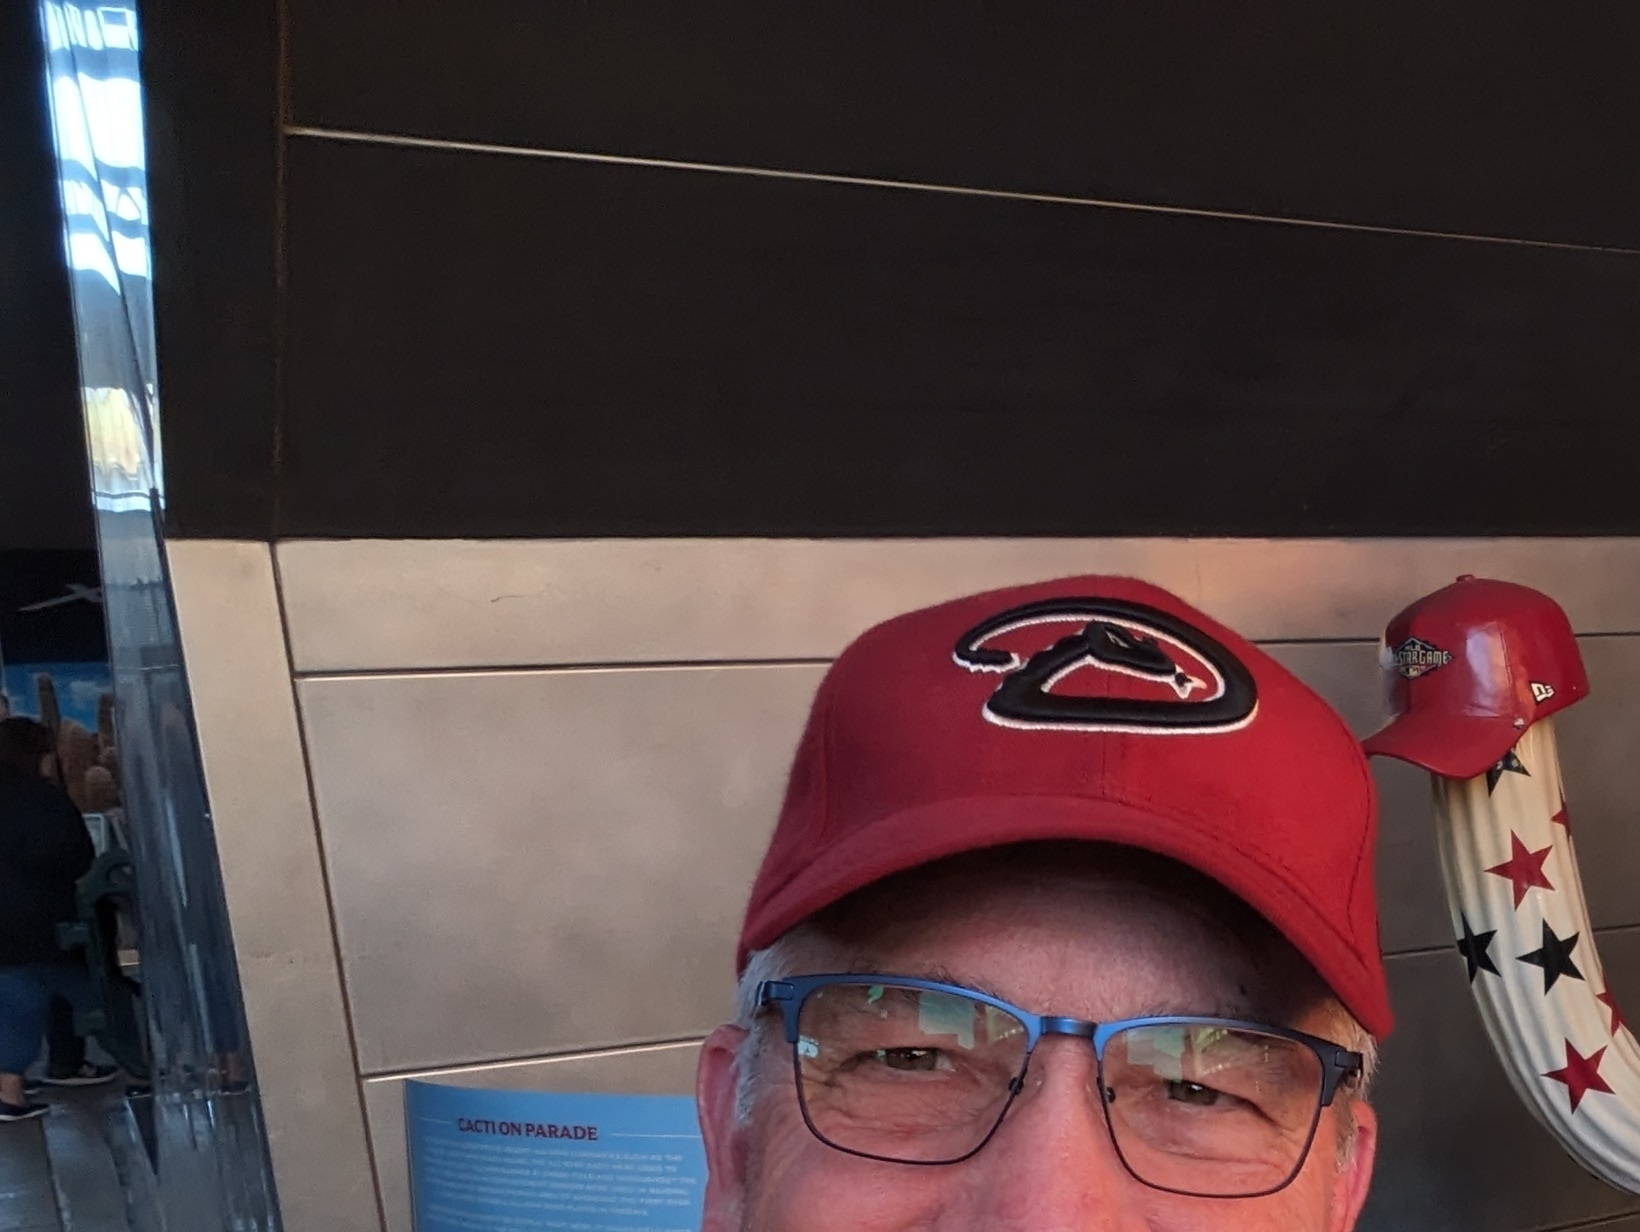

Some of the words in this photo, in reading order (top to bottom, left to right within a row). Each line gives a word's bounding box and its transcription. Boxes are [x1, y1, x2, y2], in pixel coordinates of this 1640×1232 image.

[458, 1117, 495, 1135] CACTI
[499, 1120, 522, 1136] ON
[525, 1122, 598, 1141] PARADE
